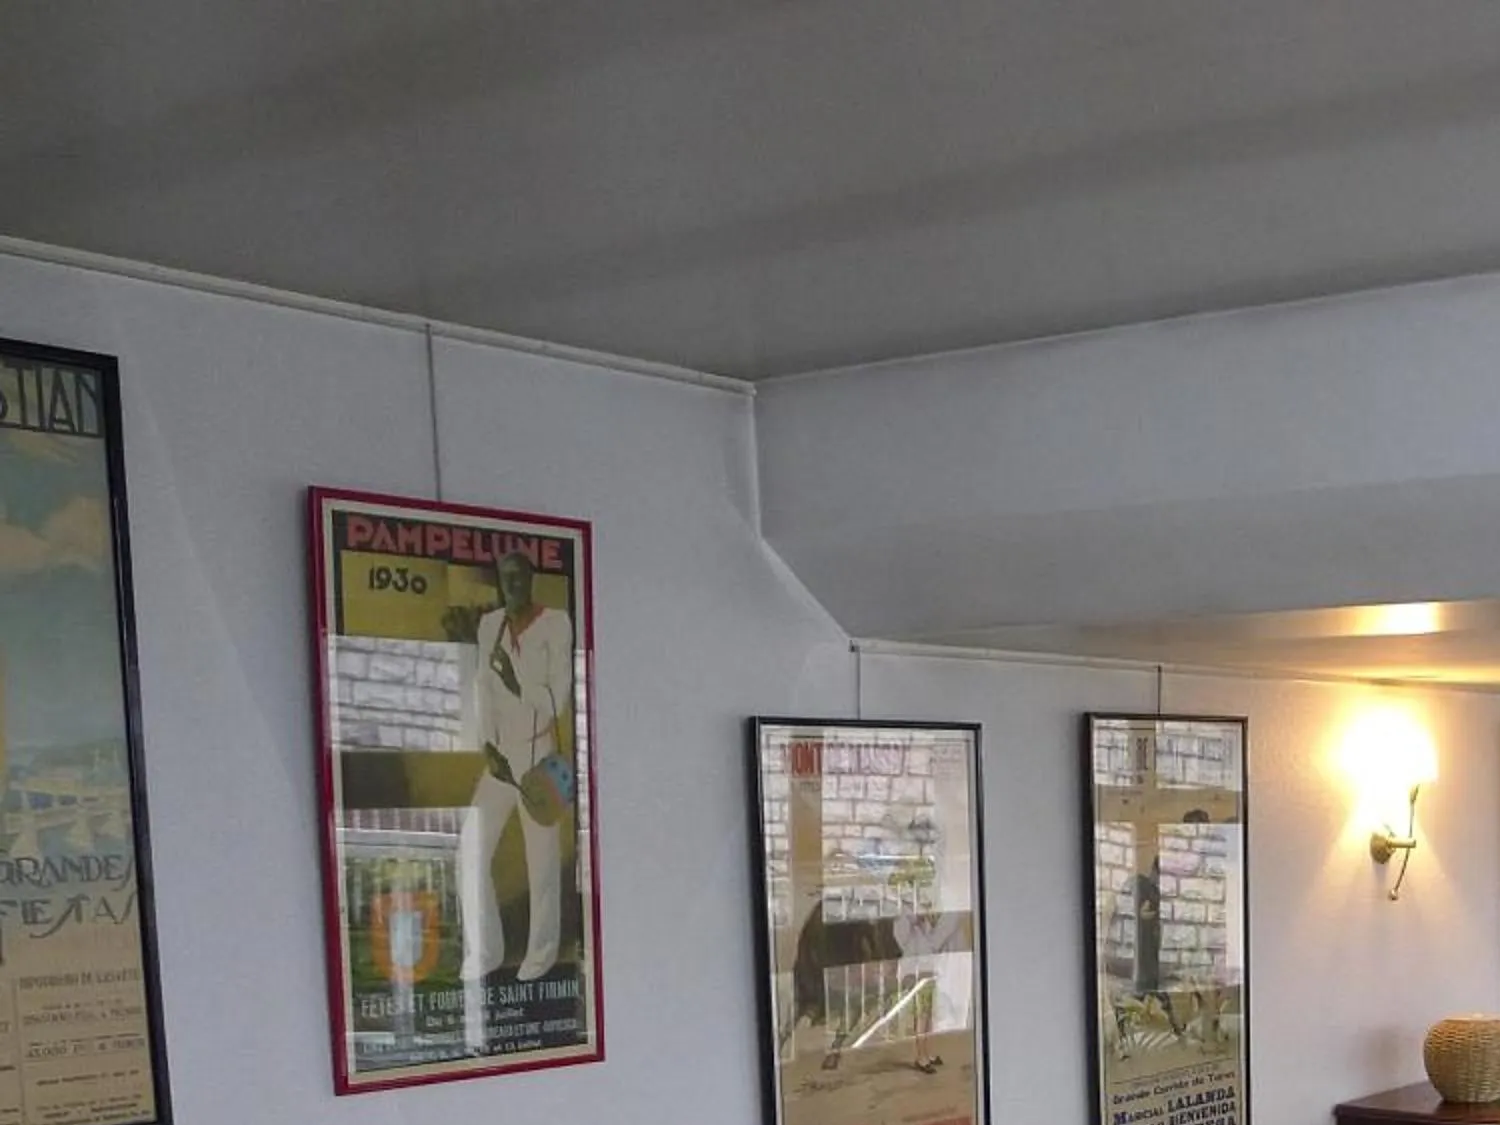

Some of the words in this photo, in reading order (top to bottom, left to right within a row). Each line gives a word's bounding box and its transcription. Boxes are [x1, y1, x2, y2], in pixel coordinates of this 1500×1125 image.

[347, 516, 563, 570] PAMPELUNE
[369, 566, 427, 594] 1930
[500, 983, 533, 1003] SAINT
[540, 977, 580, 1000] FIRMIN
[1167, 1085, 1236, 1113] LALANDA
